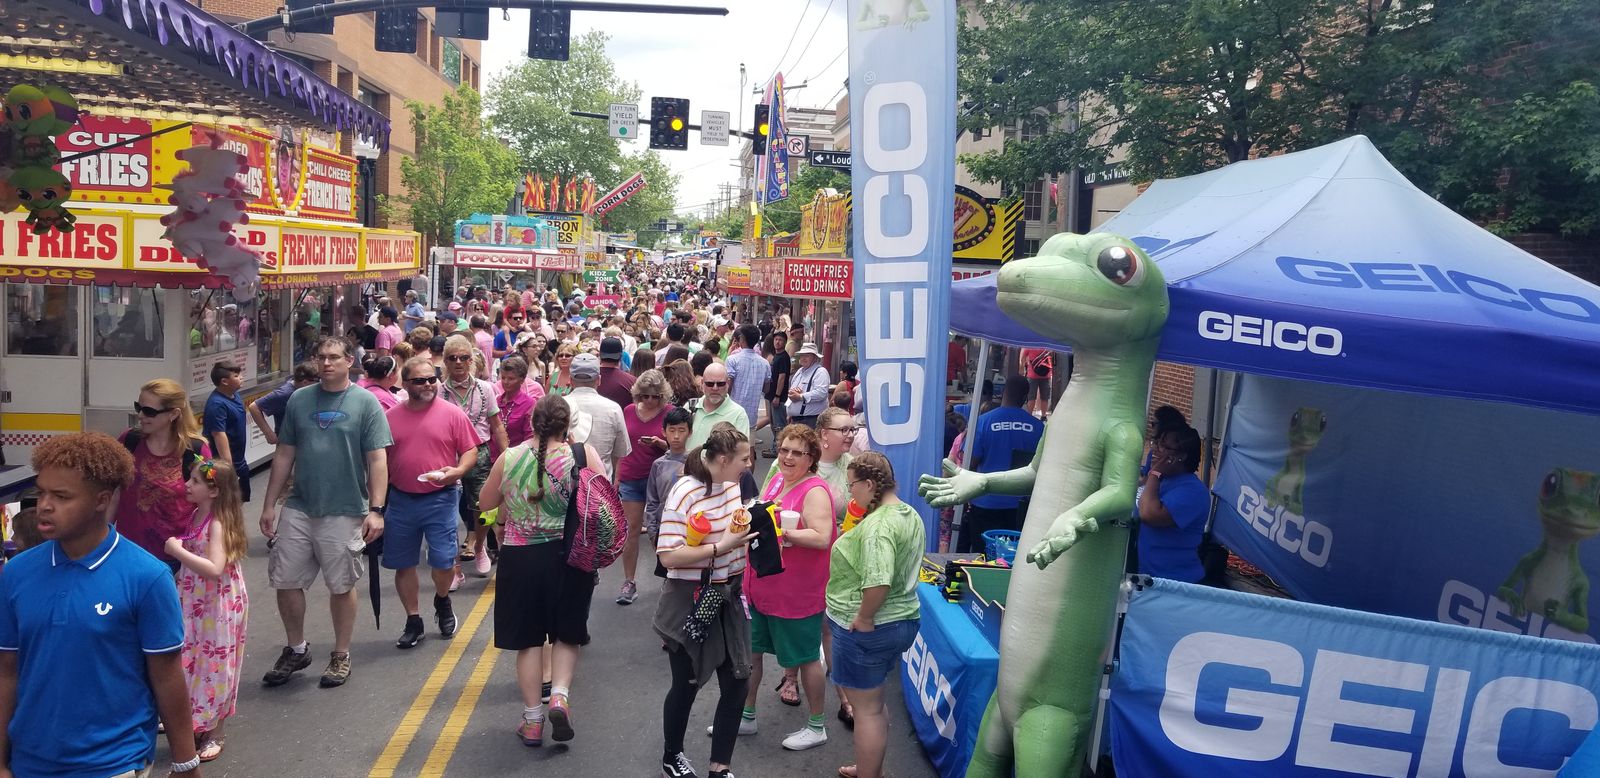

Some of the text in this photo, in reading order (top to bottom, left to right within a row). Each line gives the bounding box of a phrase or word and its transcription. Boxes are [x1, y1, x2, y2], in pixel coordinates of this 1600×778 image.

[68, 131, 141, 148] CUT
[60, 151, 149, 188] FRIES
[309, 160, 351, 182] CHILI CHEESE
[596, 176, 644, 214] CORN DOGS
[17, 220, 118, 261] FRIES
[281, 233, 357, 266] FRENCH FRIES
[394, 240, 415, 263] CAKES
[461, 254, 530, 265] POPCORN
[788, 263, 820, 277] FRENCH
[823, 264, 849, 279] FRIES
[863, 81, 929, 446] GEICO
[0, 267, 96, 279] DOGS
[286, 275, 319, 283] DRINKS
[790, 278, 845, 293] COLD DRINKS
[1275, 256, 1600, 324] GEICO
[590, 298, 614, 306] BANDS
[1198, 310, 1343, 357] GEICO
[990, 421, 1034, 433] GEICO
[1237, 484, 1334, 568] GEICO
[901, 631, 957, 741] EICO
